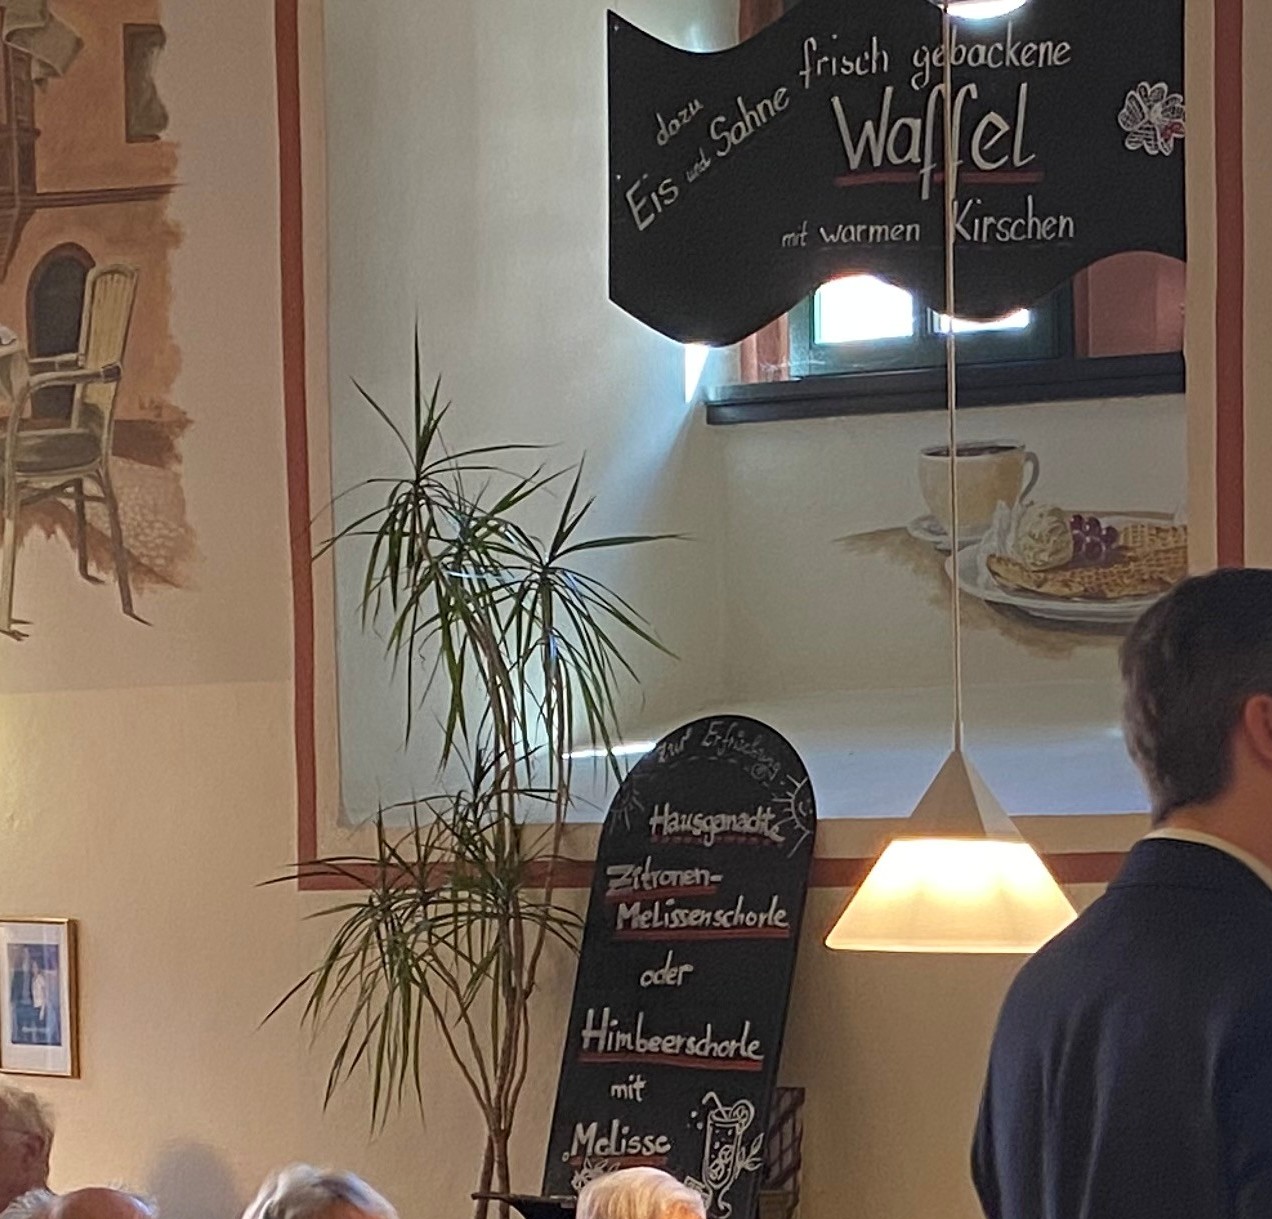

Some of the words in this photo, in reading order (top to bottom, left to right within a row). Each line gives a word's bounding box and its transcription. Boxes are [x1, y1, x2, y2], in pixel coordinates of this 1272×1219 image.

[799, 34, 889, 89] frisch
[912, 20, 1072, 91] gebackene
[655, 97, 704, 147] dazu
[831, 82, 1037, 200] Waffel
[625, 175, 680, 231] Eis
[685, 153, 712, 184] und
[709, 85, 791, 158] Sahne
[781, 220, 808, 249] mit
[820, 220, 921, 244] warmen
[950, 195, 1075, 244] Kirschen
[605, 858, 723, 897] Zitronen-
[614, 894, 790, 931] Melissenschorle
[639, 950, 694, 988] oder
[580, 1006, 765, 1062] Himbeerschorle
[611, 1072, 647, 1102] mit
[569, 1118, 673, 1157] Melisse
